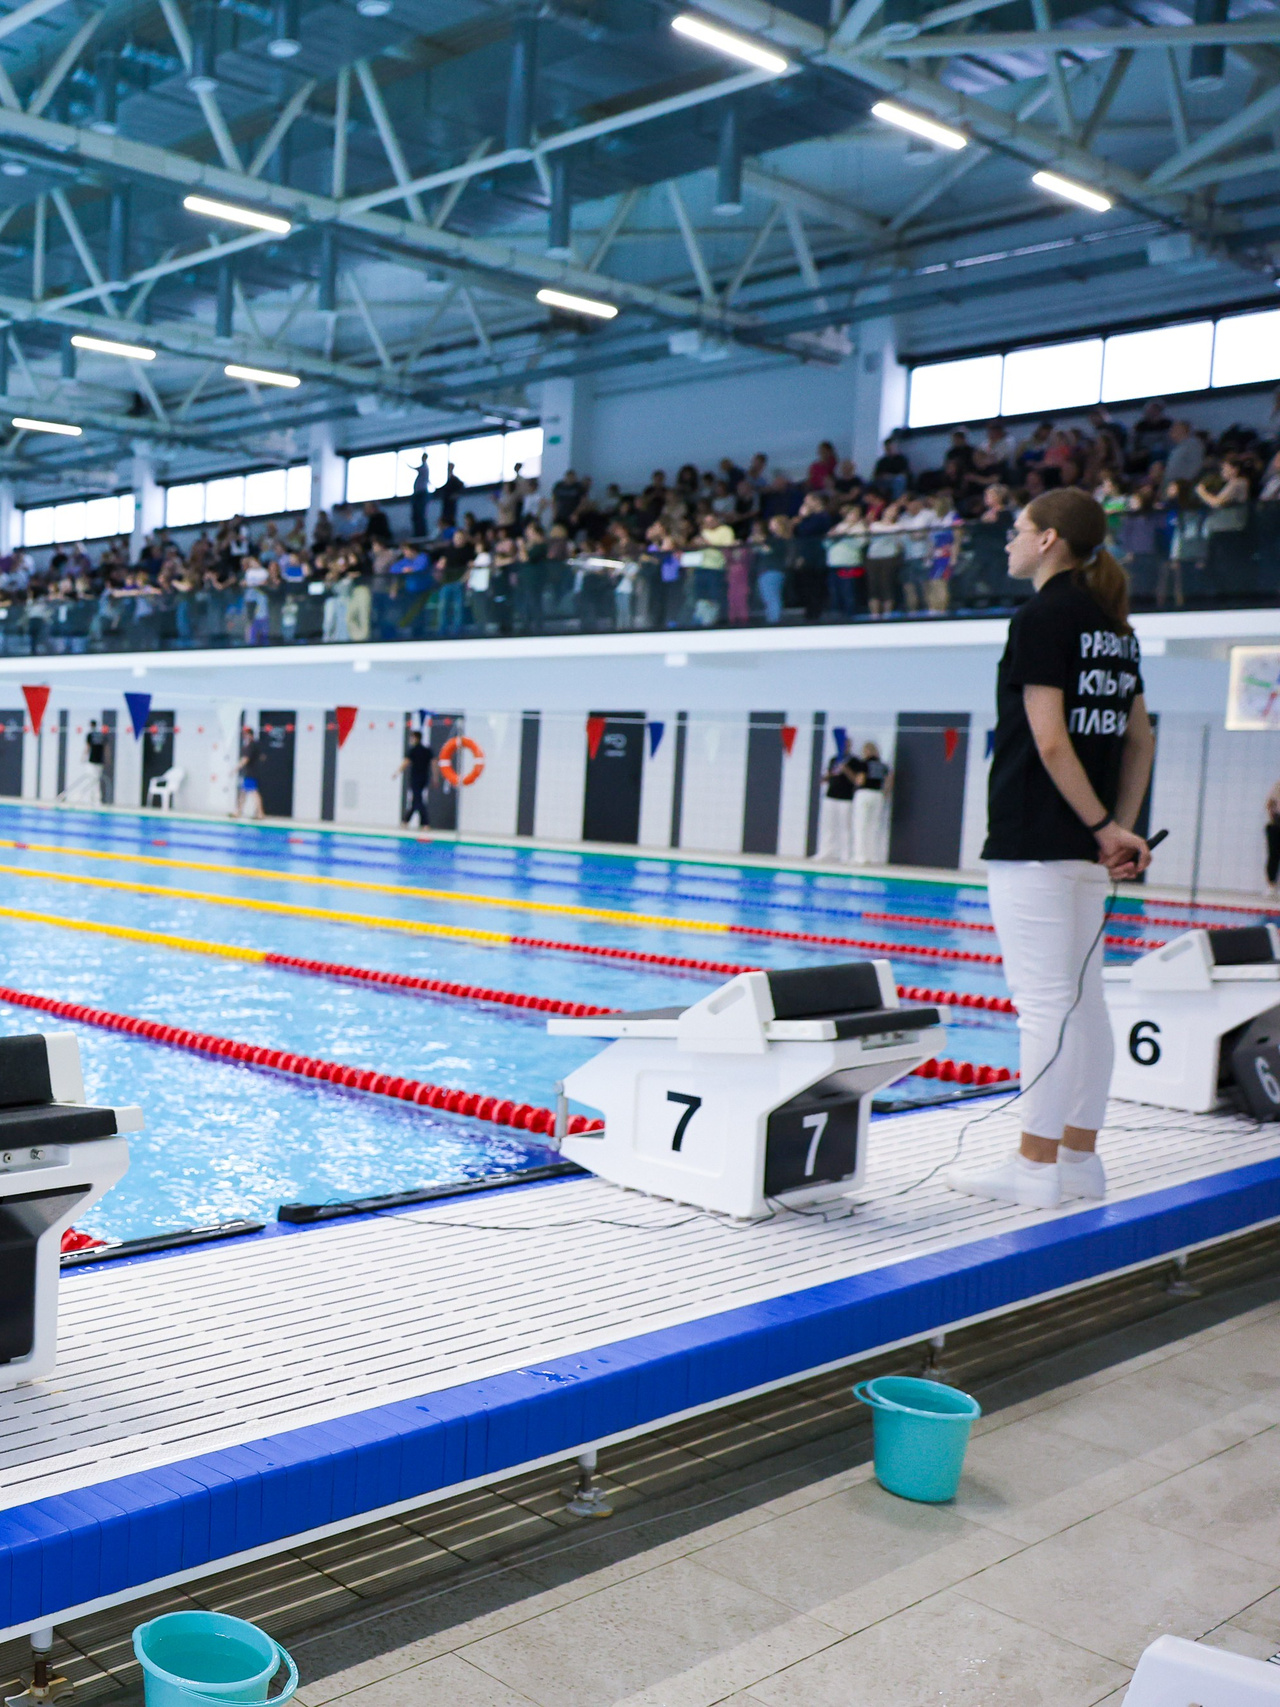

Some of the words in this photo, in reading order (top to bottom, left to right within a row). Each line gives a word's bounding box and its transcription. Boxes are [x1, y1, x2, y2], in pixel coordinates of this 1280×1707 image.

[1128, 1020, 1162, 1066] 6
[1254, 1056, 1280, 1105] 6
[666, 1090, 703, 1152] 7
[802, 1112, 829, 1176] 7
